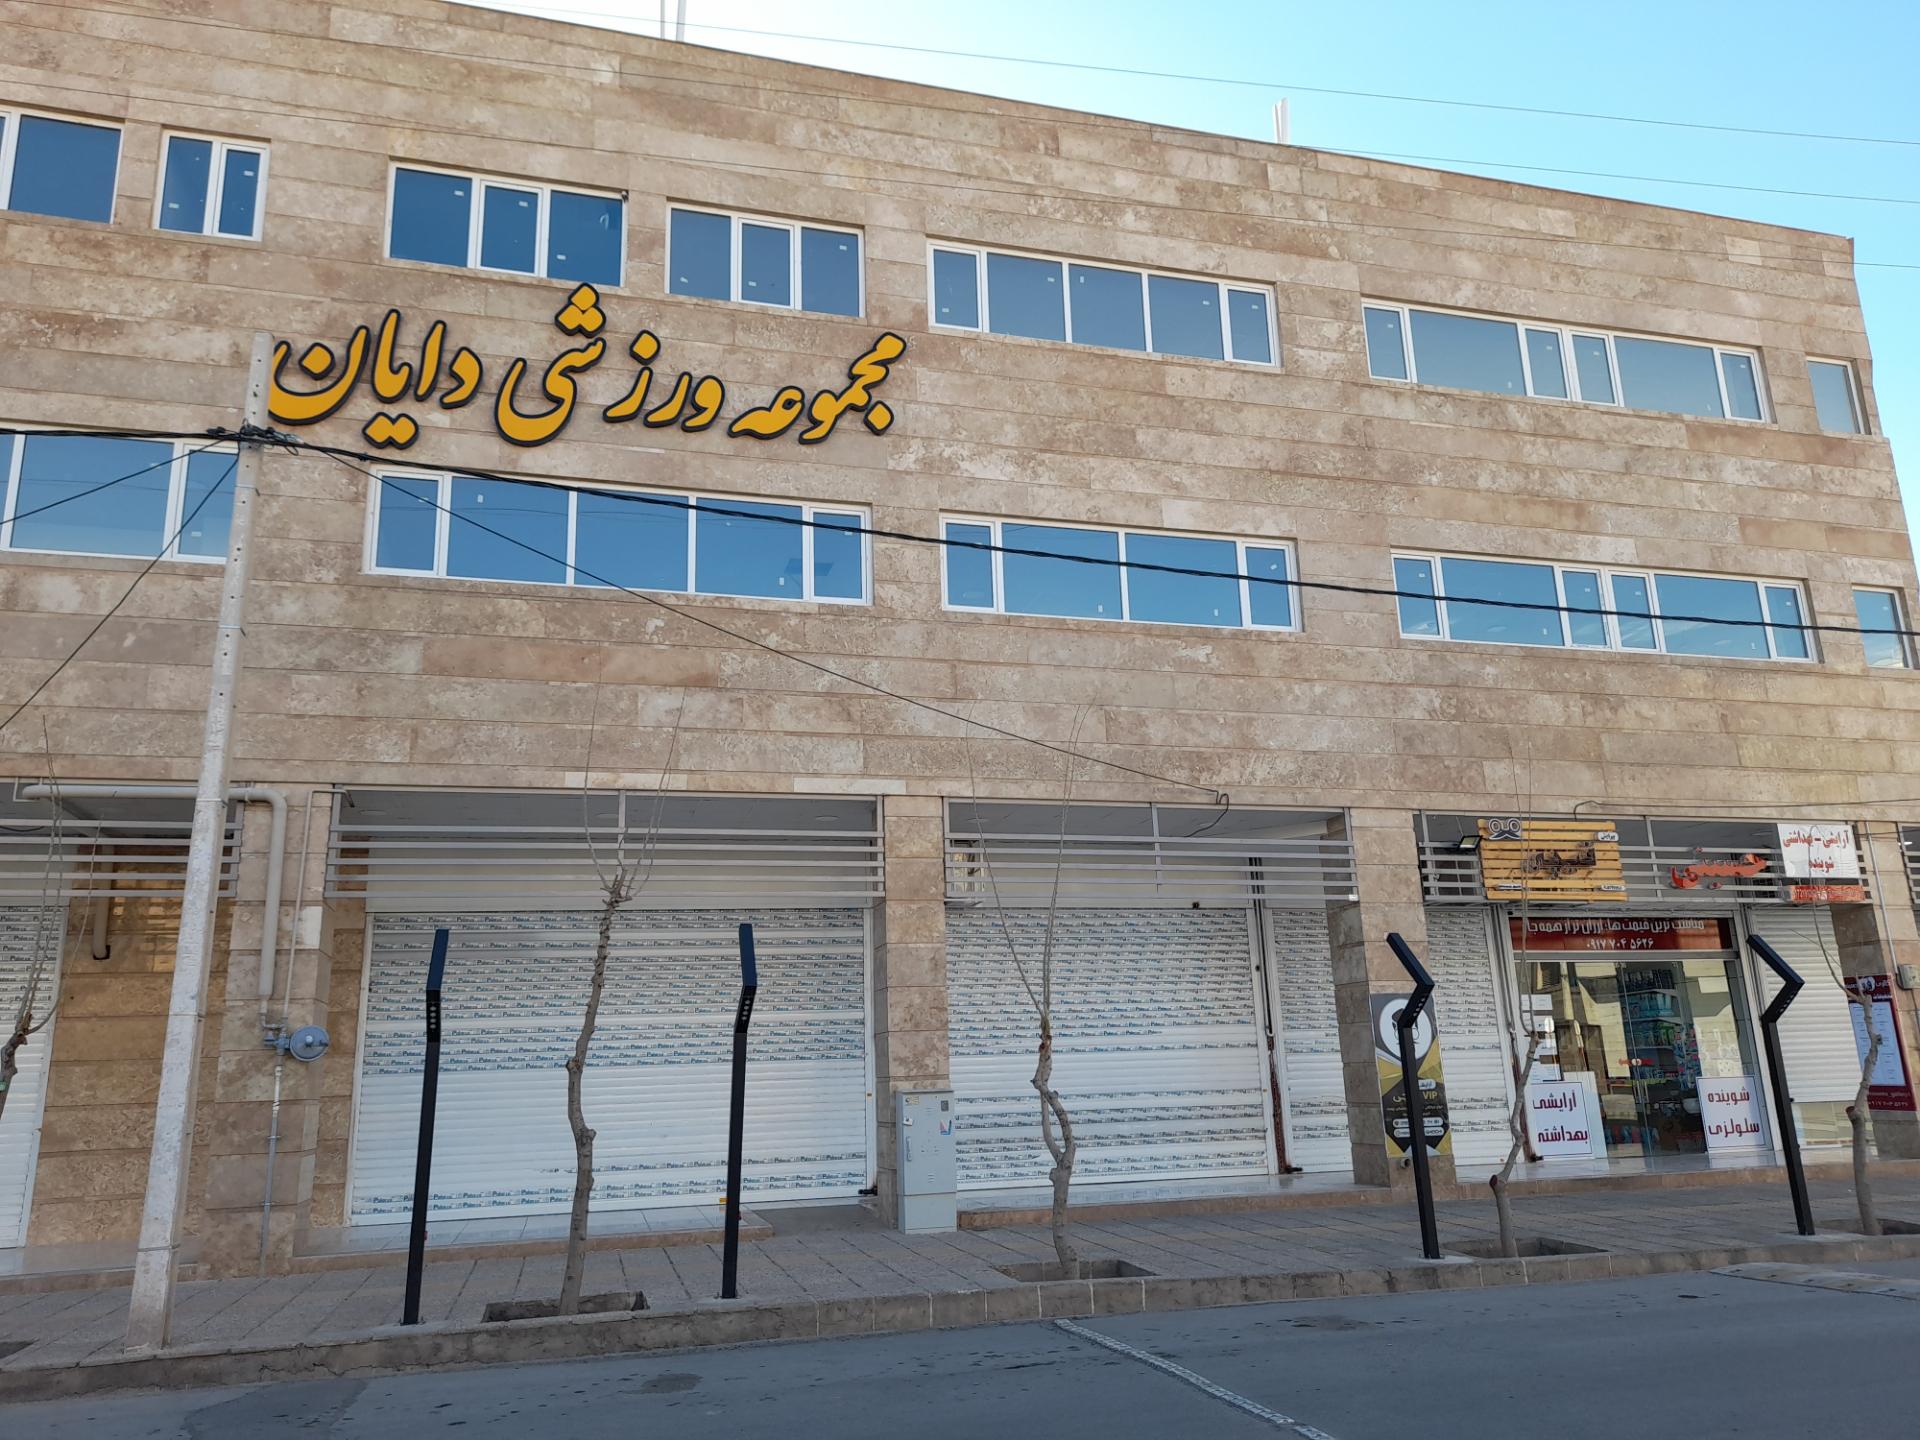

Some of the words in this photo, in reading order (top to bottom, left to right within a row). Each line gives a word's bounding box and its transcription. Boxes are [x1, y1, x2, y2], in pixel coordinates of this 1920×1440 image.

[268, 309, 483, 450] دایان
[495, 283, 725, 447] ورزشی
[727, 332, 906, 444] مجموعه
[1422, 1091, 1438, 1100] VIP
[1707, 1086, 1750, 1106] شوینده
[1707, 1118, 1761, 1138] سلولزی
